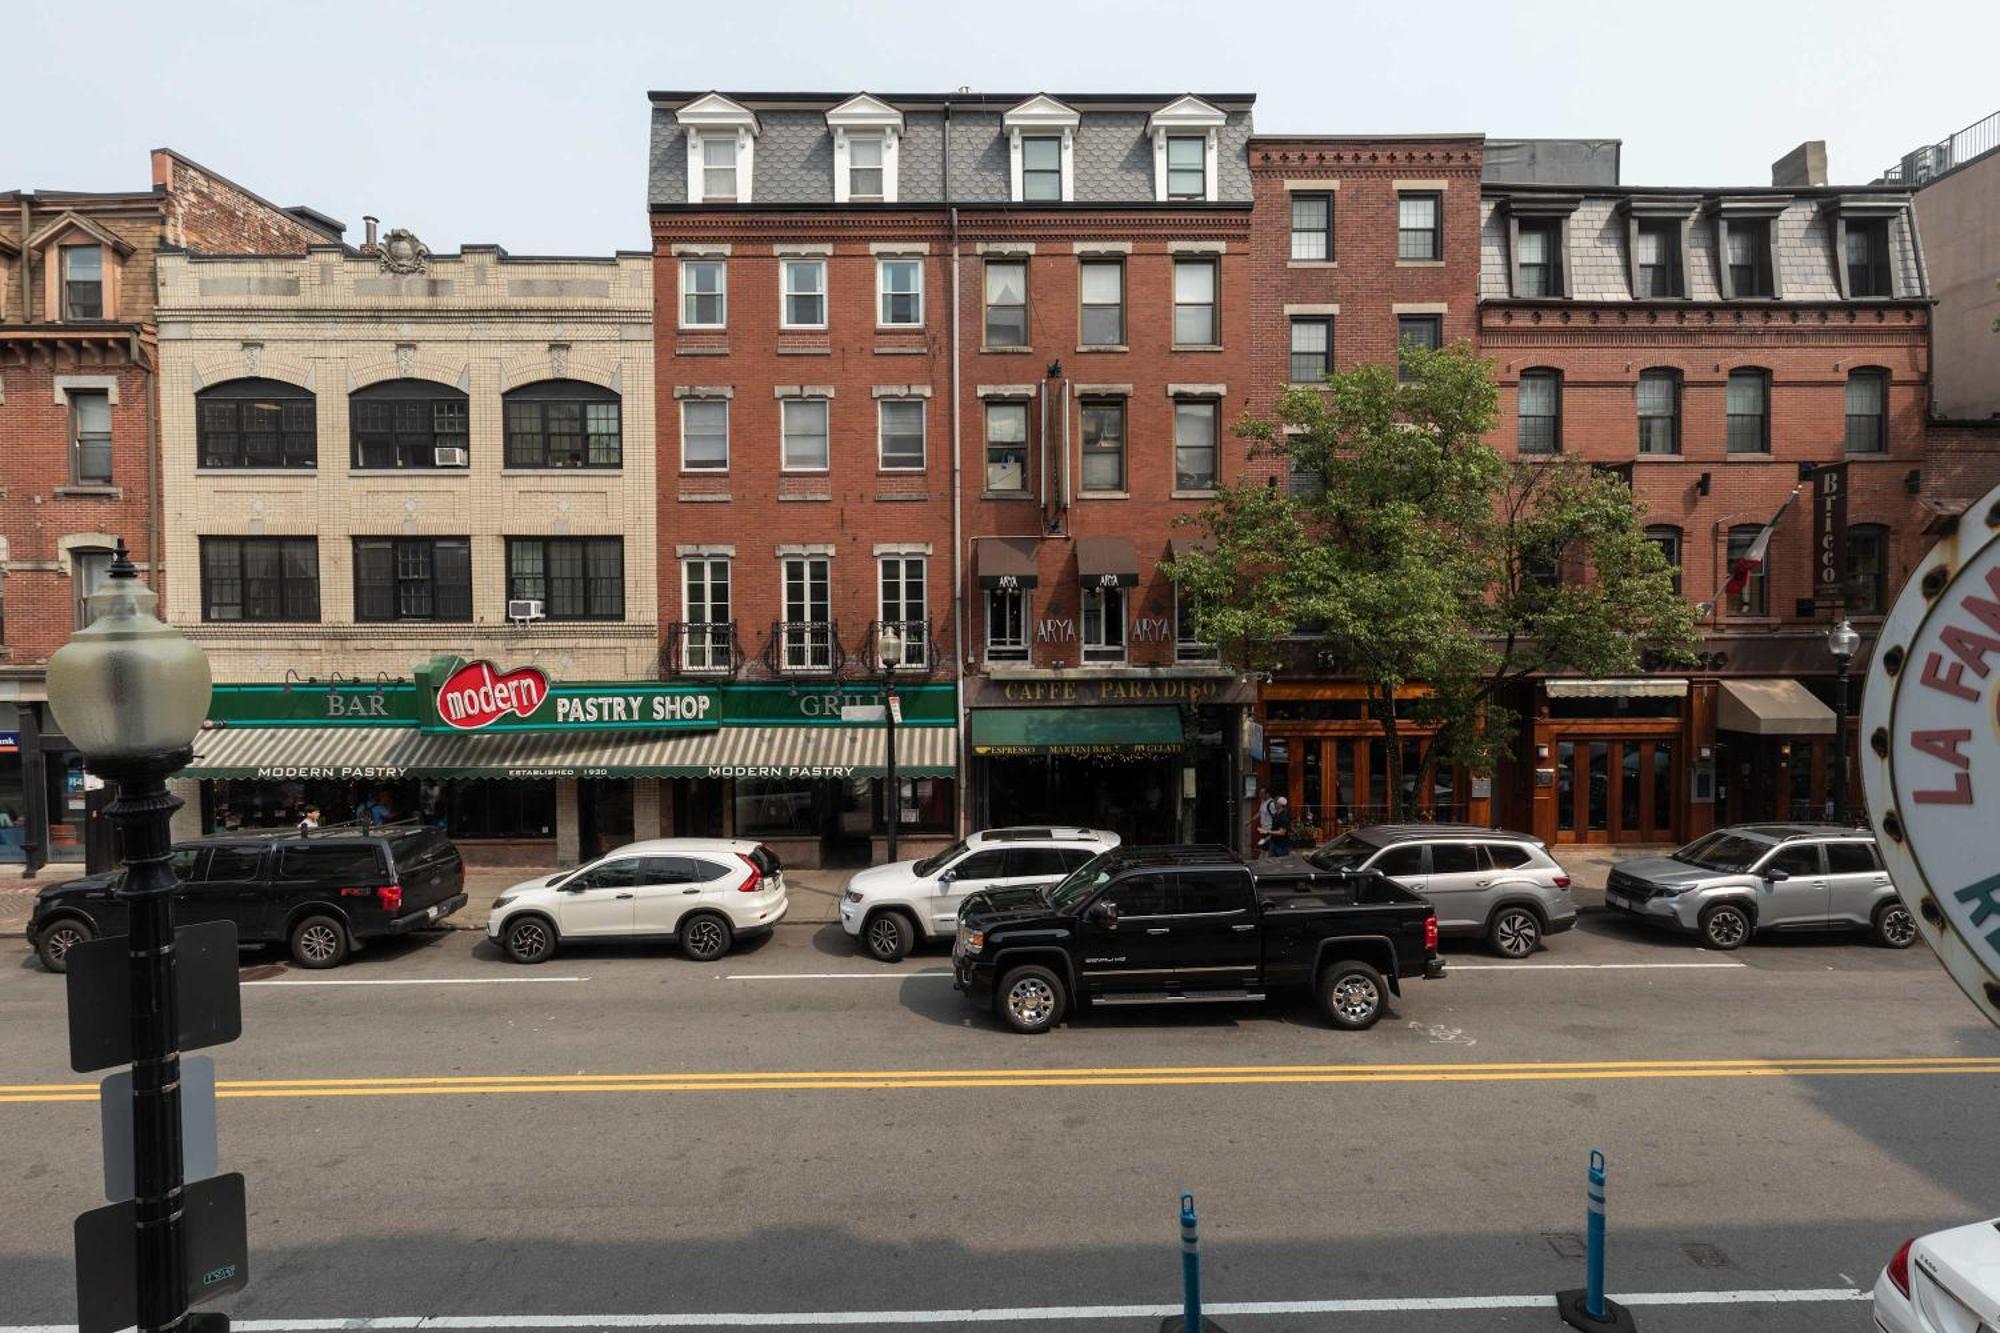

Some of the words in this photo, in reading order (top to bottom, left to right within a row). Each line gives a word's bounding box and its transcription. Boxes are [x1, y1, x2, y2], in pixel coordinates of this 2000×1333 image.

[1821, 472, 1838, 584] Bricco
[1000, 576, 1018, 588] ARYA
[1100, 575, 1119, 587] ARYA
[1037, 618, 1076, 643] ARYA
[1132, 617, 1172, 642] ARYA
[446, 663, 538, 721] modern
[556, 696, 643, 723] PASTRY
[652, 694, 711, 721] SHOP
[1005, 681, 1077, 700] CAFFE
[326, 695, 389, 716] BAR
[991, 744, 1036, 755] ESPRESSO
[1049, 744, 1090, 754] MARTINI
[1092, 744, 1112, 754] BAR
[258, 767, 334, 777] MODERN
[341, 767, 408, 777] PASTRY
[583, 768, 608, 776] 1930
[708, 766, 782, 777] MODERN
[789, 766, 854, 777] PASTRY
[1911, 728, 1973, 806] LA
